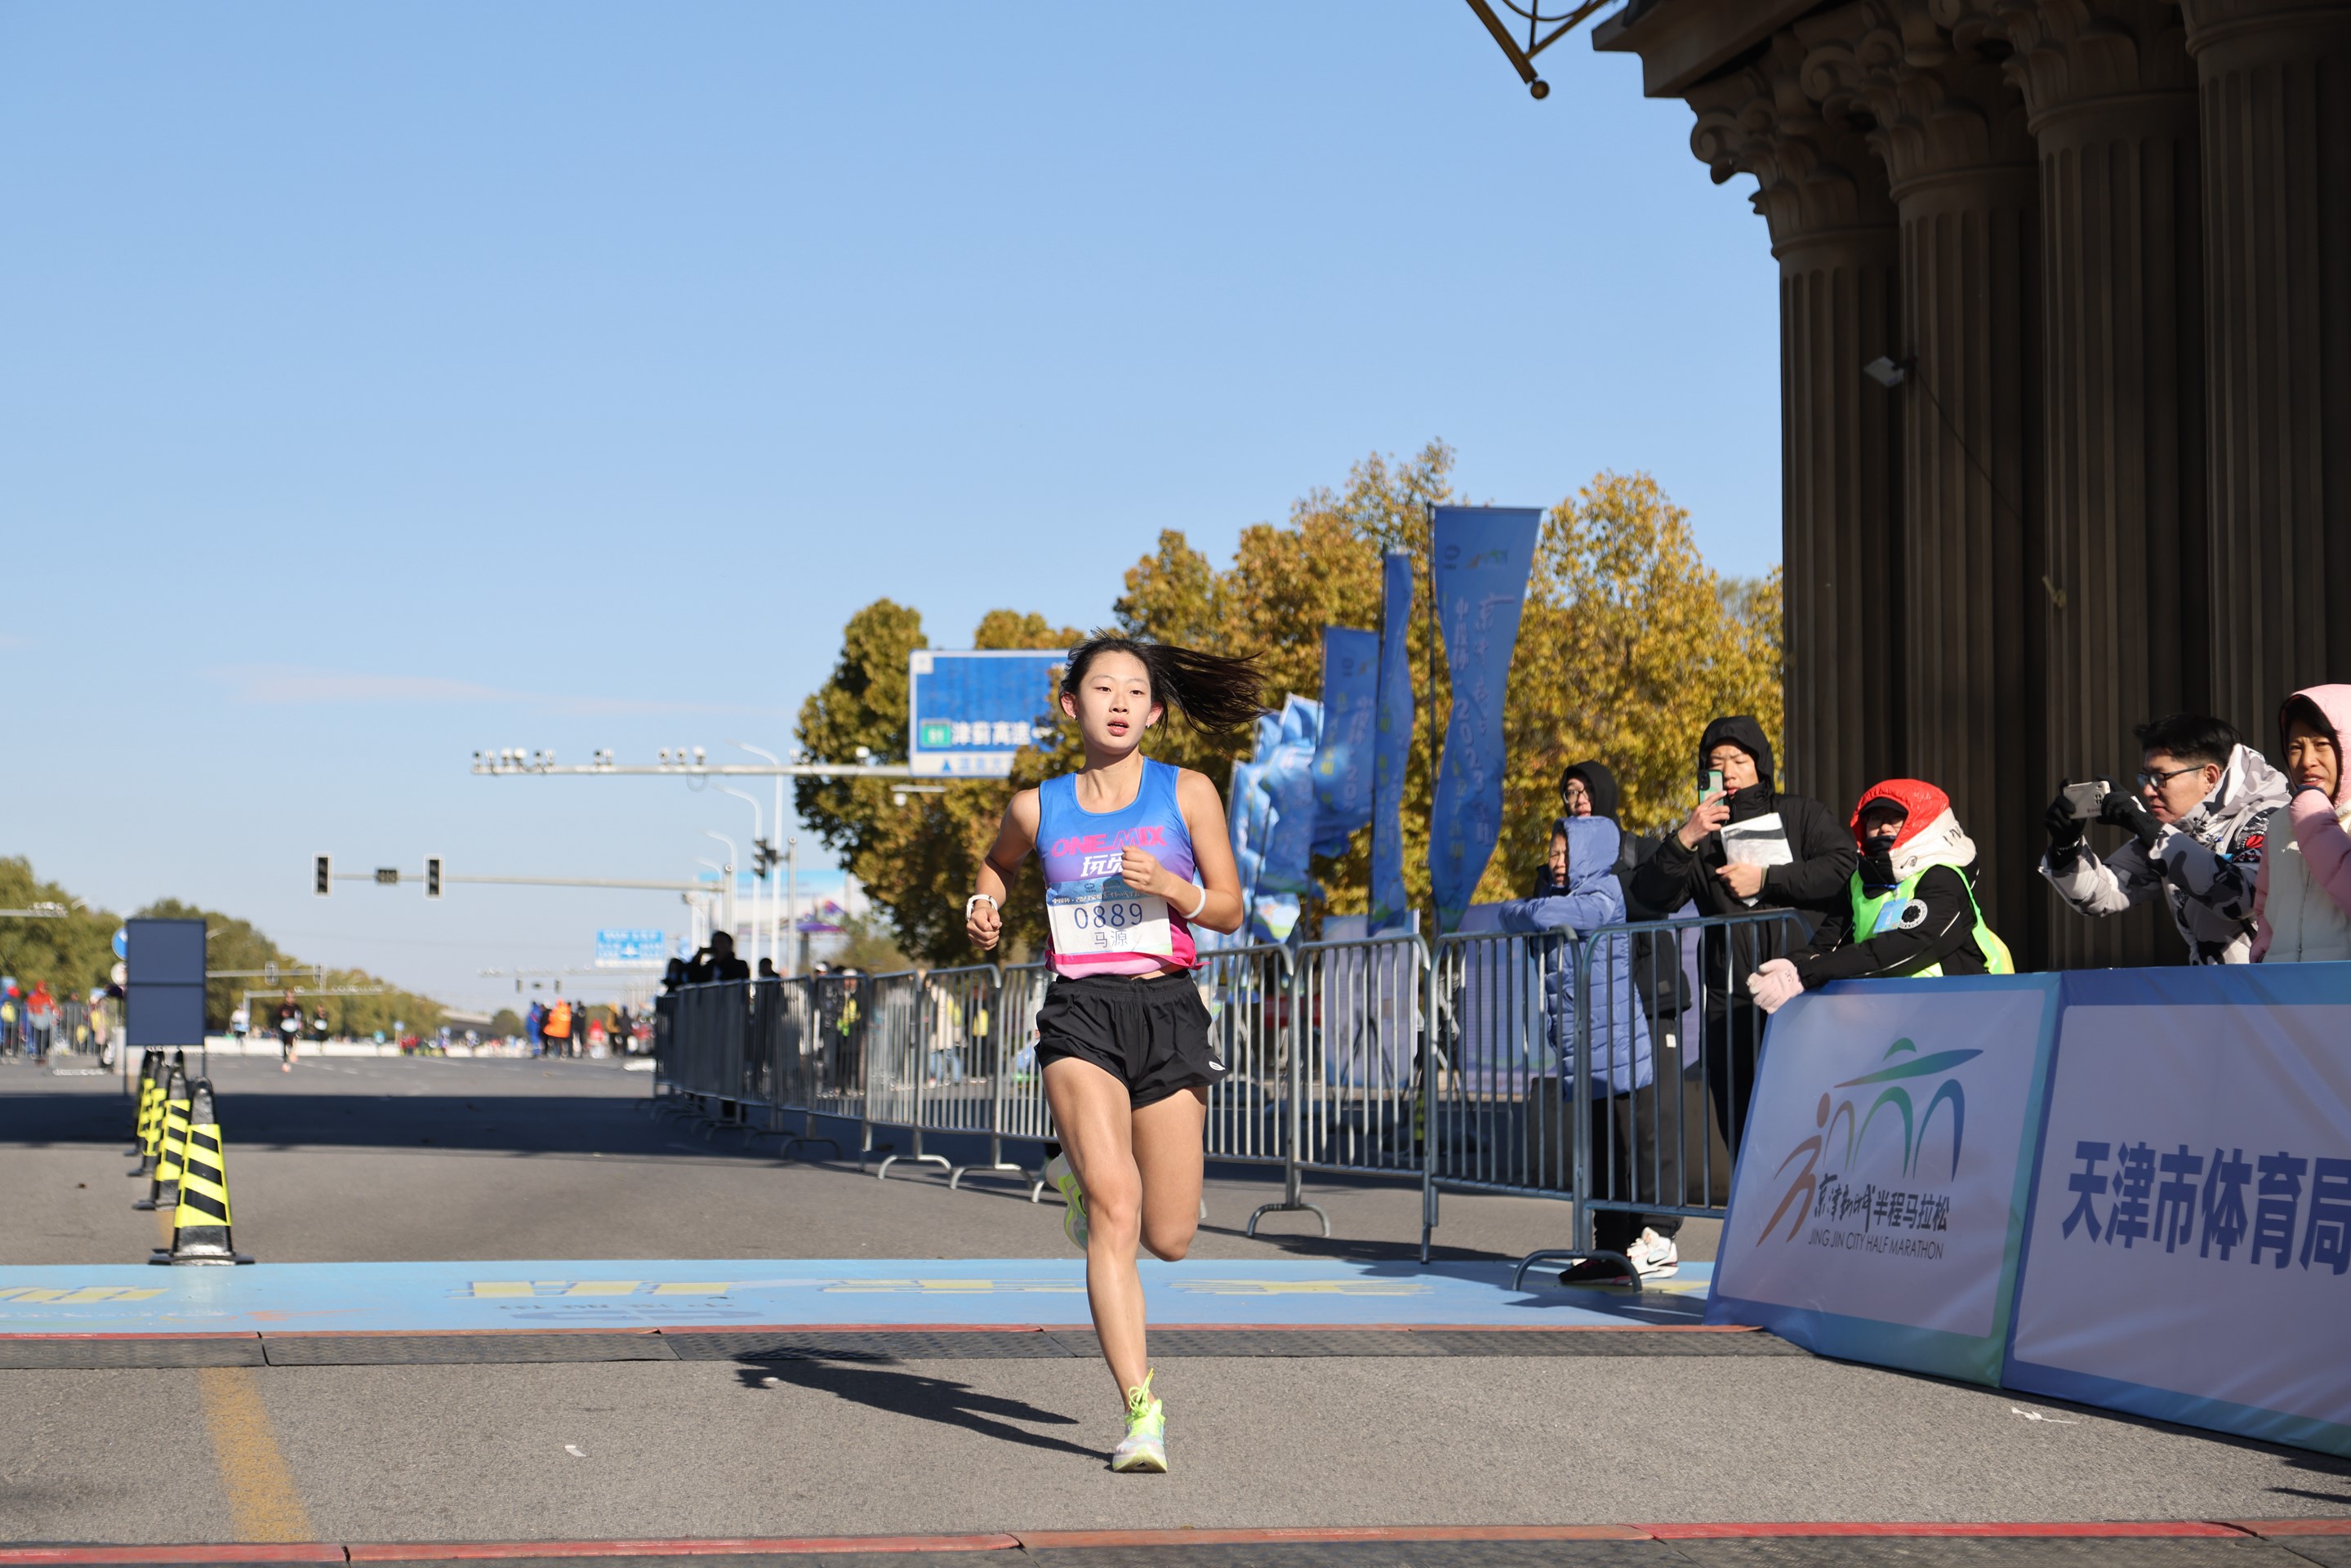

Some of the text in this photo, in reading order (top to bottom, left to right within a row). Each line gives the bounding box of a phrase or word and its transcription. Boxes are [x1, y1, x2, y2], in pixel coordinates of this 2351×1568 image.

[1051, 826, 1167, 858] ONE MIX
[1074, 902, 1142, 929] 0889
[1094, 929, 1128, 948] 马源
[2062, 1140, 2351, 1276] 天津市体育局
[1808, 1228, 1944, 1259] JING JIN CITY HALF MARATHON
